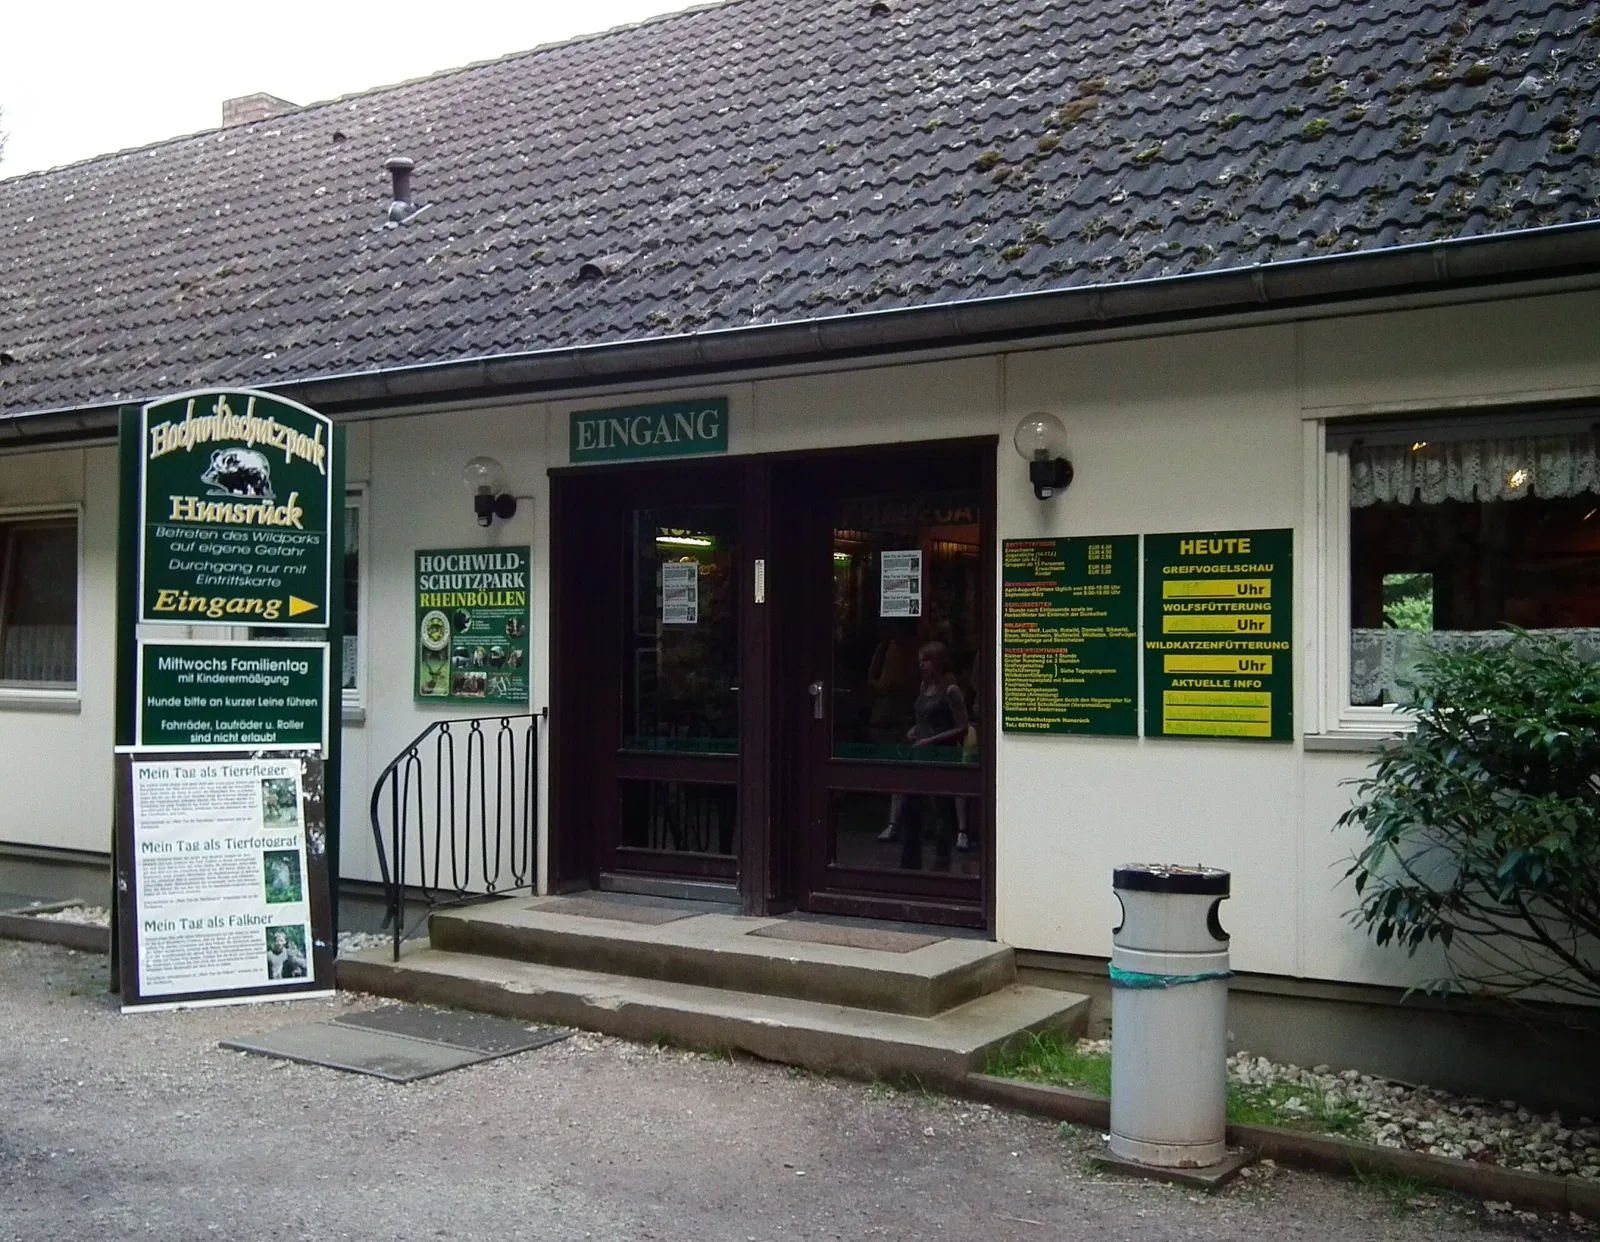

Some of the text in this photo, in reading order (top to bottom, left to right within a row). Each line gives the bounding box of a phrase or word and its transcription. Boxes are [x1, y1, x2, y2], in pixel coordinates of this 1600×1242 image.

[150, 395, 326, 475] Hochwildschutzpark
[576, 409, 720, 451] EINGANG
[169, 491, 303, 529] Hunsrück
[156, 526, 320, 545] Betreten des Wildparks
[170, 541, 305, 557] auf eigene Gefahr
[1180, 538, 1251, 555] HEUTE
[169, 559, 307, 575] Durchgang nur mit
[419, 552, 525, 573] HOCHWILD-
[1162, 564, 1274, 574] GREIFVOGELSCHAU
[196, 573, 282, 588] Eintrittskarte
[419, 572, 525, 590] SCHUTZPARK
[1237, 583, 1265, 595] Uhr
[153, 589, 282, 619] Eingang
[420, 588, 526, 607] RHEINBÖLLEN
[1163, 602, 1272, 612] WOLFSFÜTTERUNG
[1237, 619, 1265, 631] Uhr
[1145, 640, 1290, 650] WILDKATZENFÜTTERUNG
[158, 657, 309, 675] Mittwochs Familientag
[1238, 660, 1266, 671] Uhr
[178, 672, 290, 687] mit Kinderermäßigung
[1171, 679, 1262, 688] AKTUELLE INFO
[147, 697, 318, 707] Hunde bitte an kurzer Leine führen
[161, 719, 304, 732] Fahrräder, Laufräder u. Roller
[190, 732, 277, 743] sind nicht erlaubt
[139, 764, 287, 780] Mein Tag als Tierpfleger
[141, 835, 298, 854] Mein Tag als Tierfotograf
[144, 913, 274, 933] Mein Tag als Falkner
